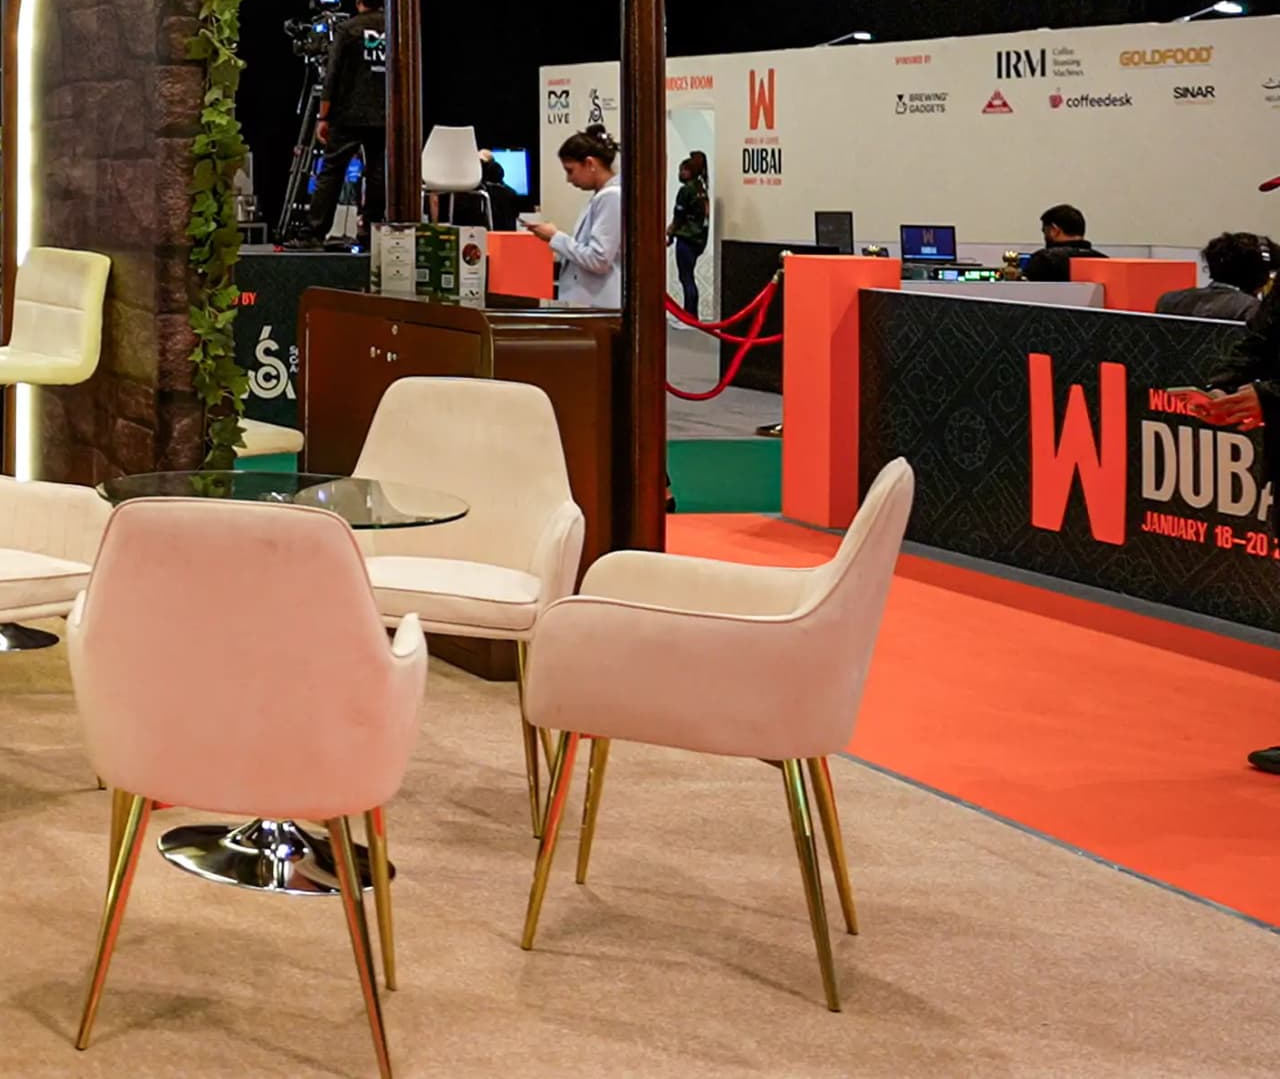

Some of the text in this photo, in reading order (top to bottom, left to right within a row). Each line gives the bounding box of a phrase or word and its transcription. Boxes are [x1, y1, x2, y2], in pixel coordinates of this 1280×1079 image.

[364, 49, 386, 61] LIV
[996, 48, 1046, 79] IRM
[1120, 47, 1211, 66] GOLDFOOD
[750, 69, 775, 130] W
[1066, 94, 1133, 108] coffeedesk
[1173, 86, 1216, 99] SINAR
[909, 103, 946, 113] GADGETS
[548, 113, 570, 124] LIVE
[742, 148, 782, 174] DUBAI
[241, 292, 257, 305] BY
[1028, 353, 1127, 546] W
[1142, 420, 1274, 521] DUB
[1142, 511, 1208, 543] JANUARY
